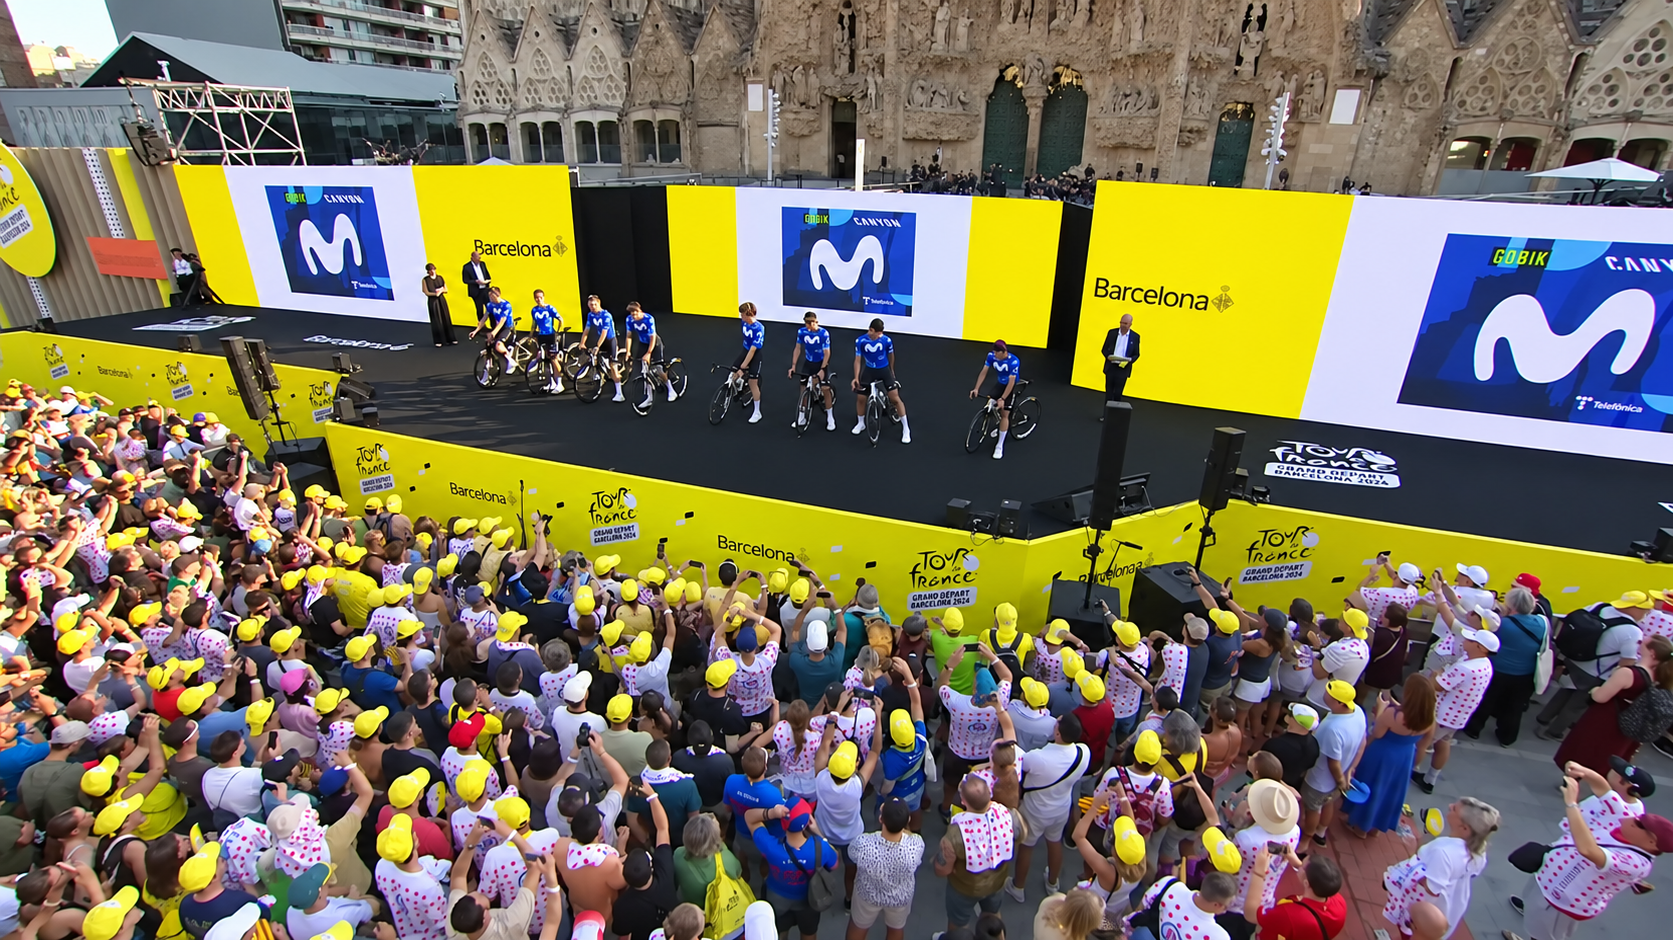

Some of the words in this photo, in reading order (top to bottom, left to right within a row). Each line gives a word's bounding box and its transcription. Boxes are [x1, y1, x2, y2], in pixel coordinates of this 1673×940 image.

[853, 217, 902, 228] CANYON
[474, 239, 552, 257] Barcelona
[1492, 248, 1549, 267] GOBIK
[1094, 277, 1209, 311] Barcelona
[1594, 401, 1643, 413] Telefónica
[450, 482, 507, 505] Barcelona
[718, 535, 795, 563] Barcelona
